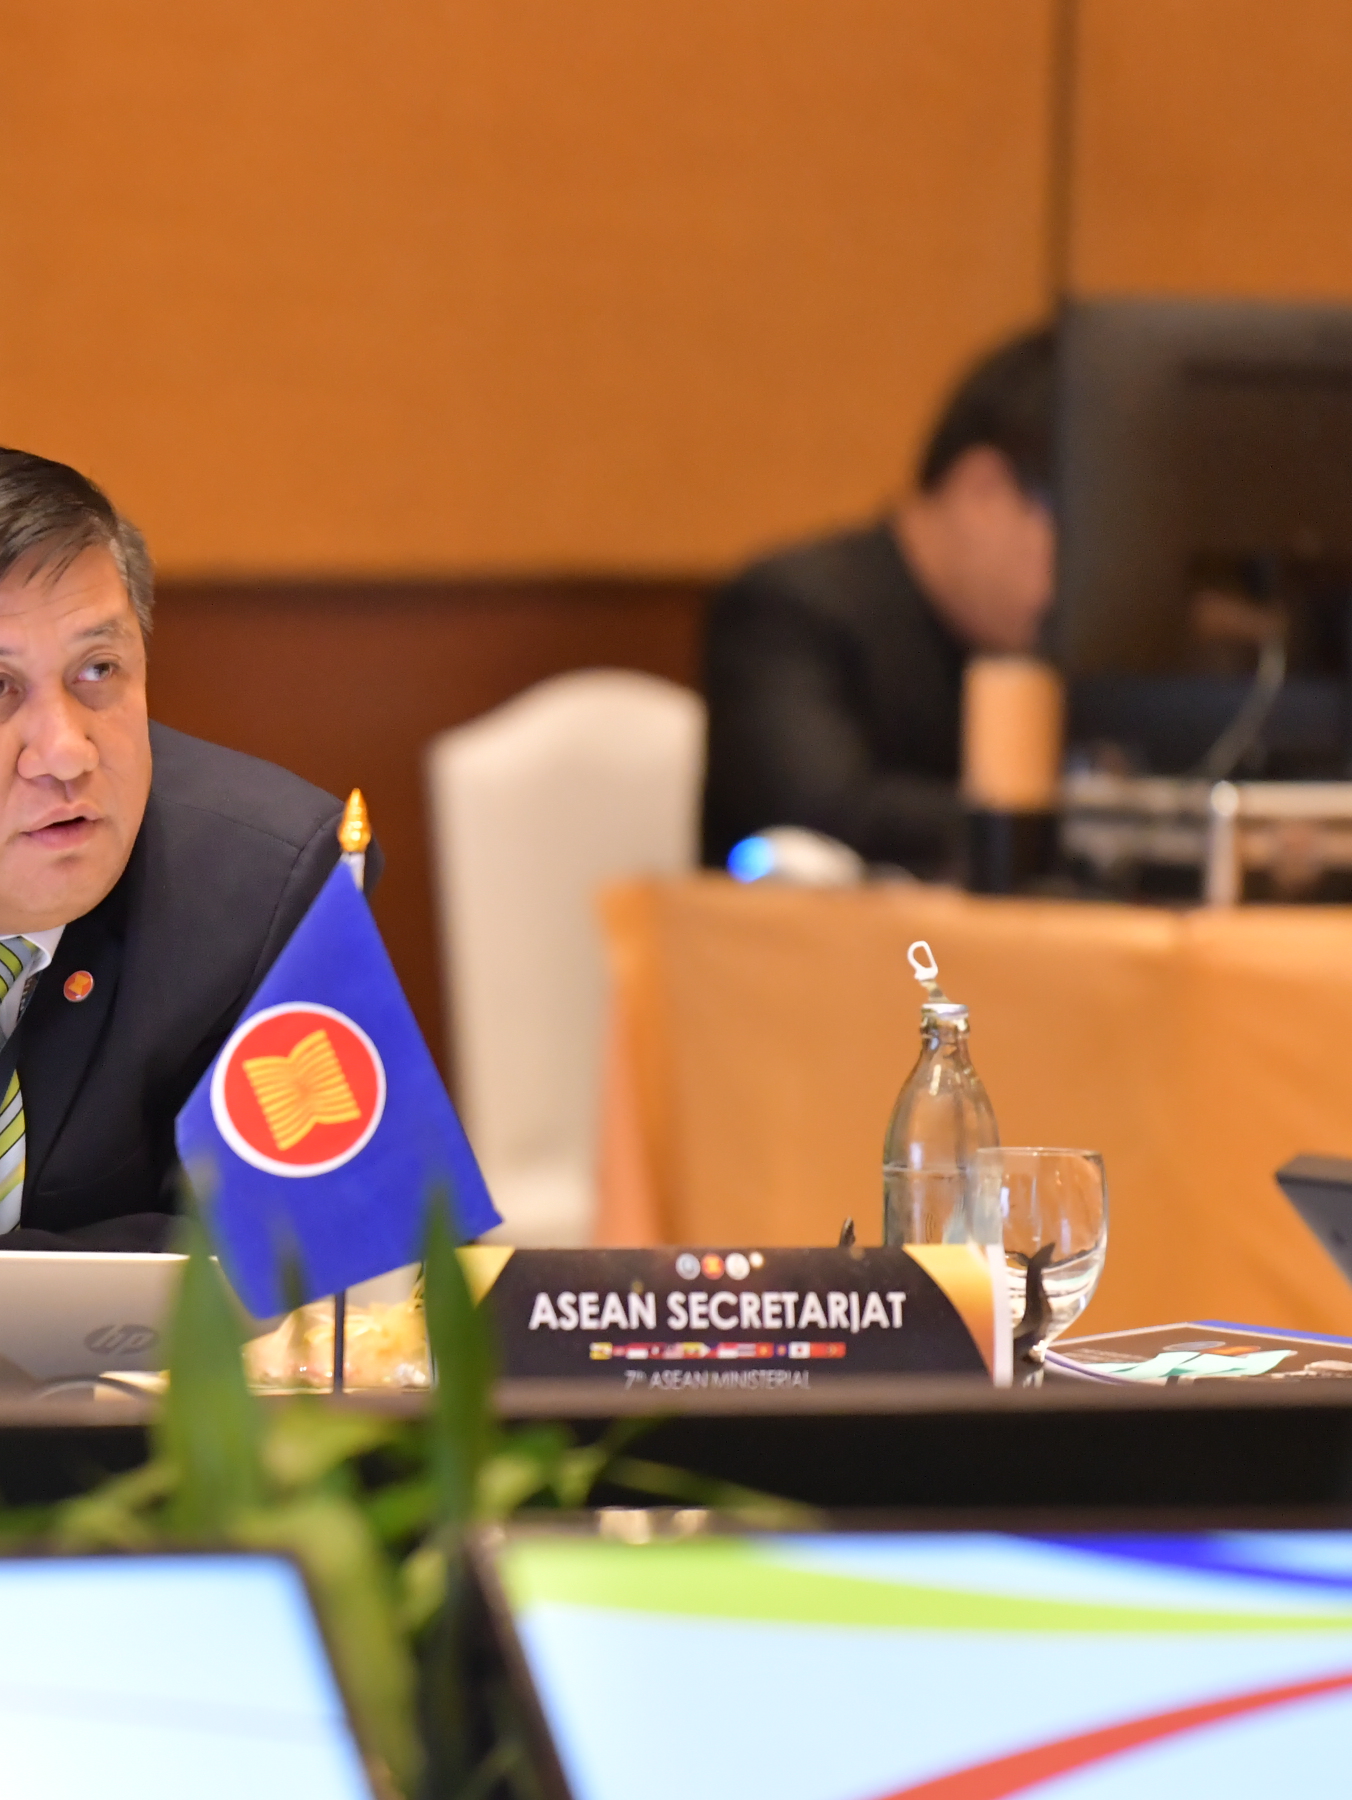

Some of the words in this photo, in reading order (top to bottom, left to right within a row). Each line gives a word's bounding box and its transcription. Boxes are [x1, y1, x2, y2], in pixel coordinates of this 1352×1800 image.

[528, 1291, 657, 1330] ASEAN
[649, 1369, 709, 1391] ASEAN
[711, 1369, 812, 1391] MINISTERIAL
